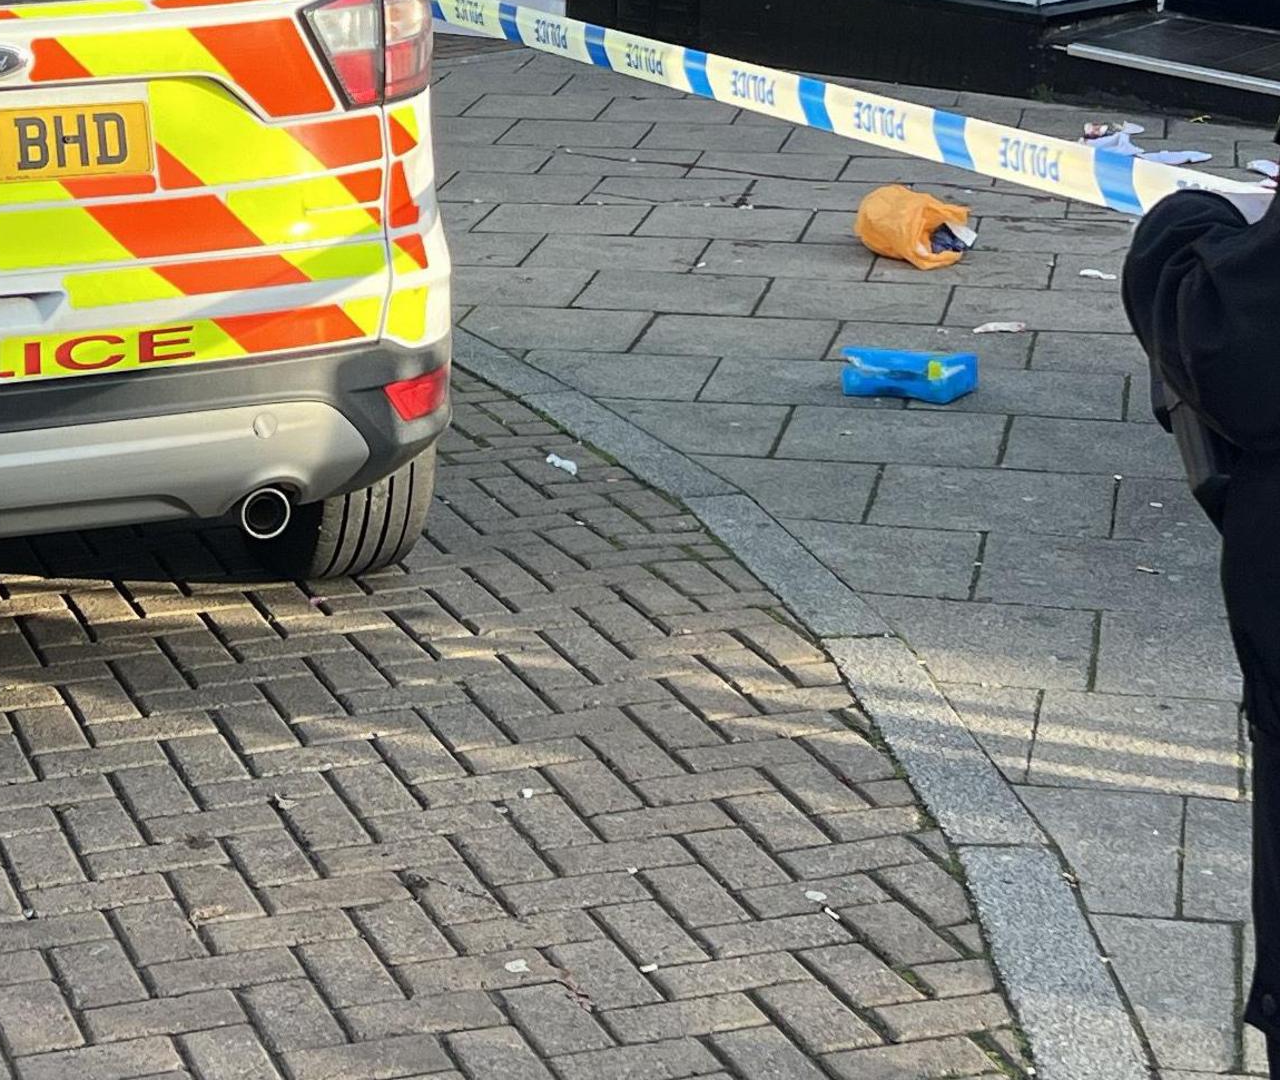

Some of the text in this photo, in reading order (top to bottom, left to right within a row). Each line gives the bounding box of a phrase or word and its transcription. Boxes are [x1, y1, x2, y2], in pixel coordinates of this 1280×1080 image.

[533, 17, 570, 50] POLICE
[624, 42, 664, 78] POLICE
[730, 70, 776, 108] POLICE
[853, 100, 906, 142] POLICE
[16, 111, 130, 172] BHD
[998, 136, 1062, 184] POLICE
